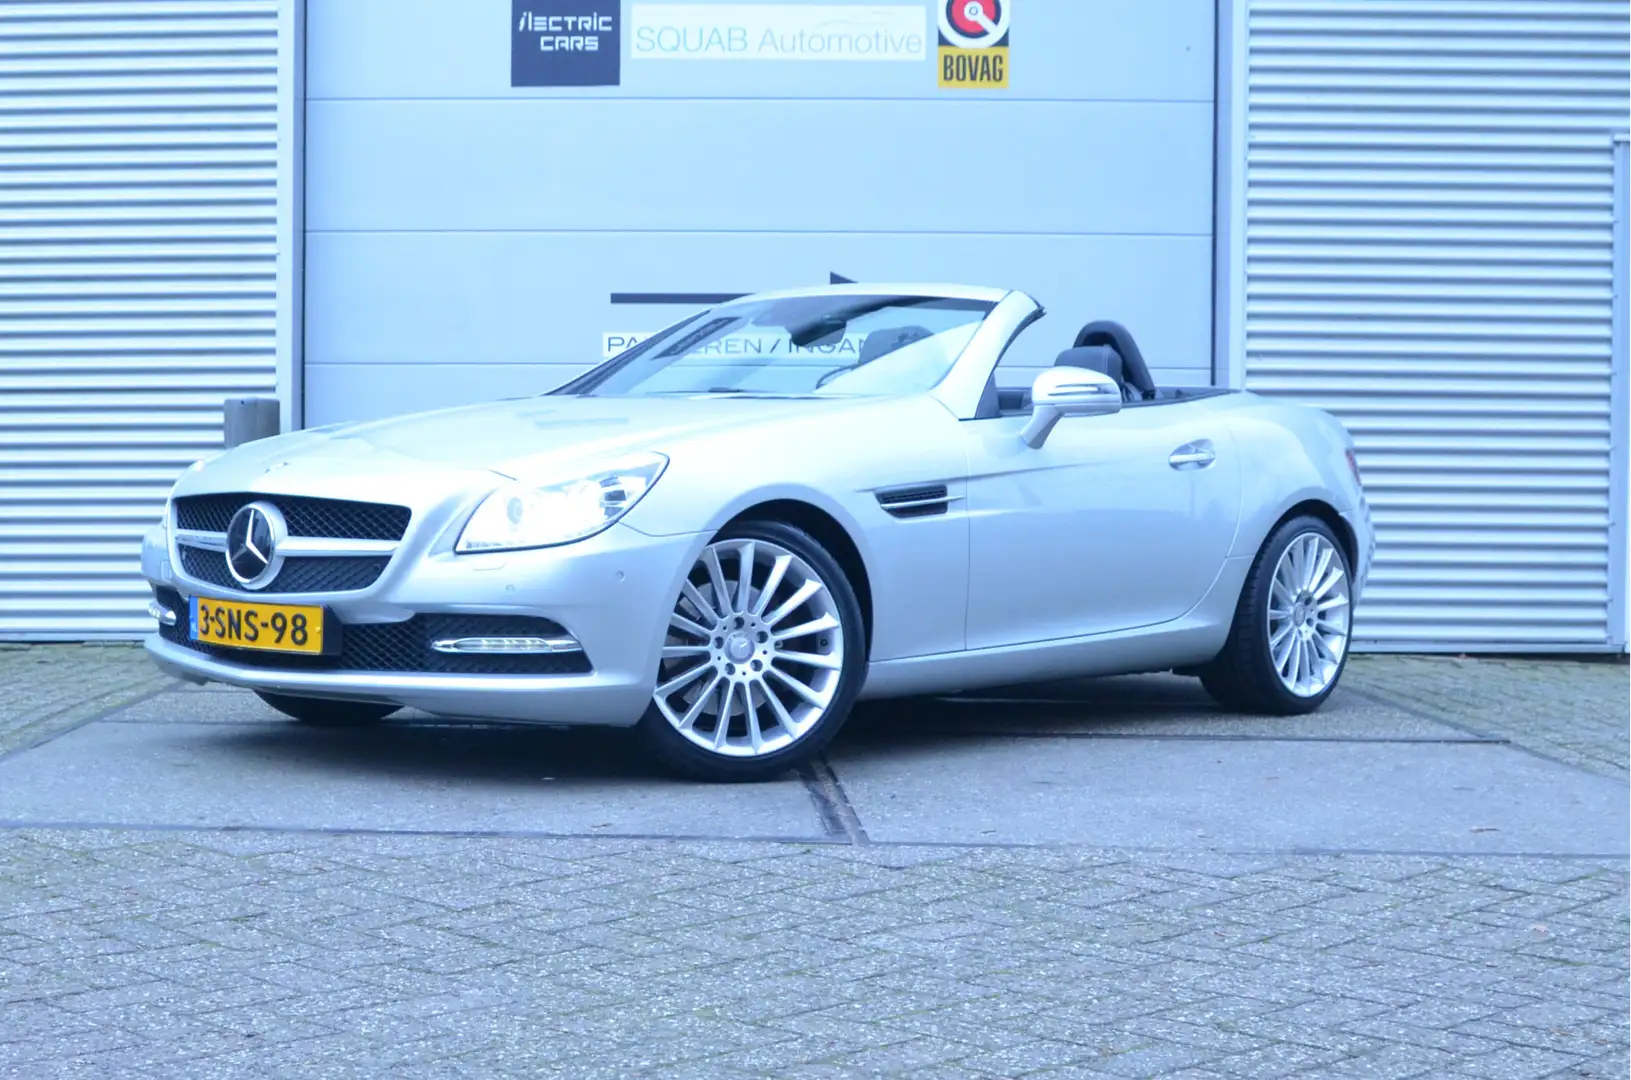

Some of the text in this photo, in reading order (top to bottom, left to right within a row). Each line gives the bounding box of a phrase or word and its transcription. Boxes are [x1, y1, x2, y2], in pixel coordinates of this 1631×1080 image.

[540, 35, 599, 51] CARS
[636, 26, 922, 54] SQUAB Automotive
[943, 54, 1004, 82] BOVAG
[607, 336, 762, 354] PAREN
[200, 604, 308, 646] 3-SNS-98
